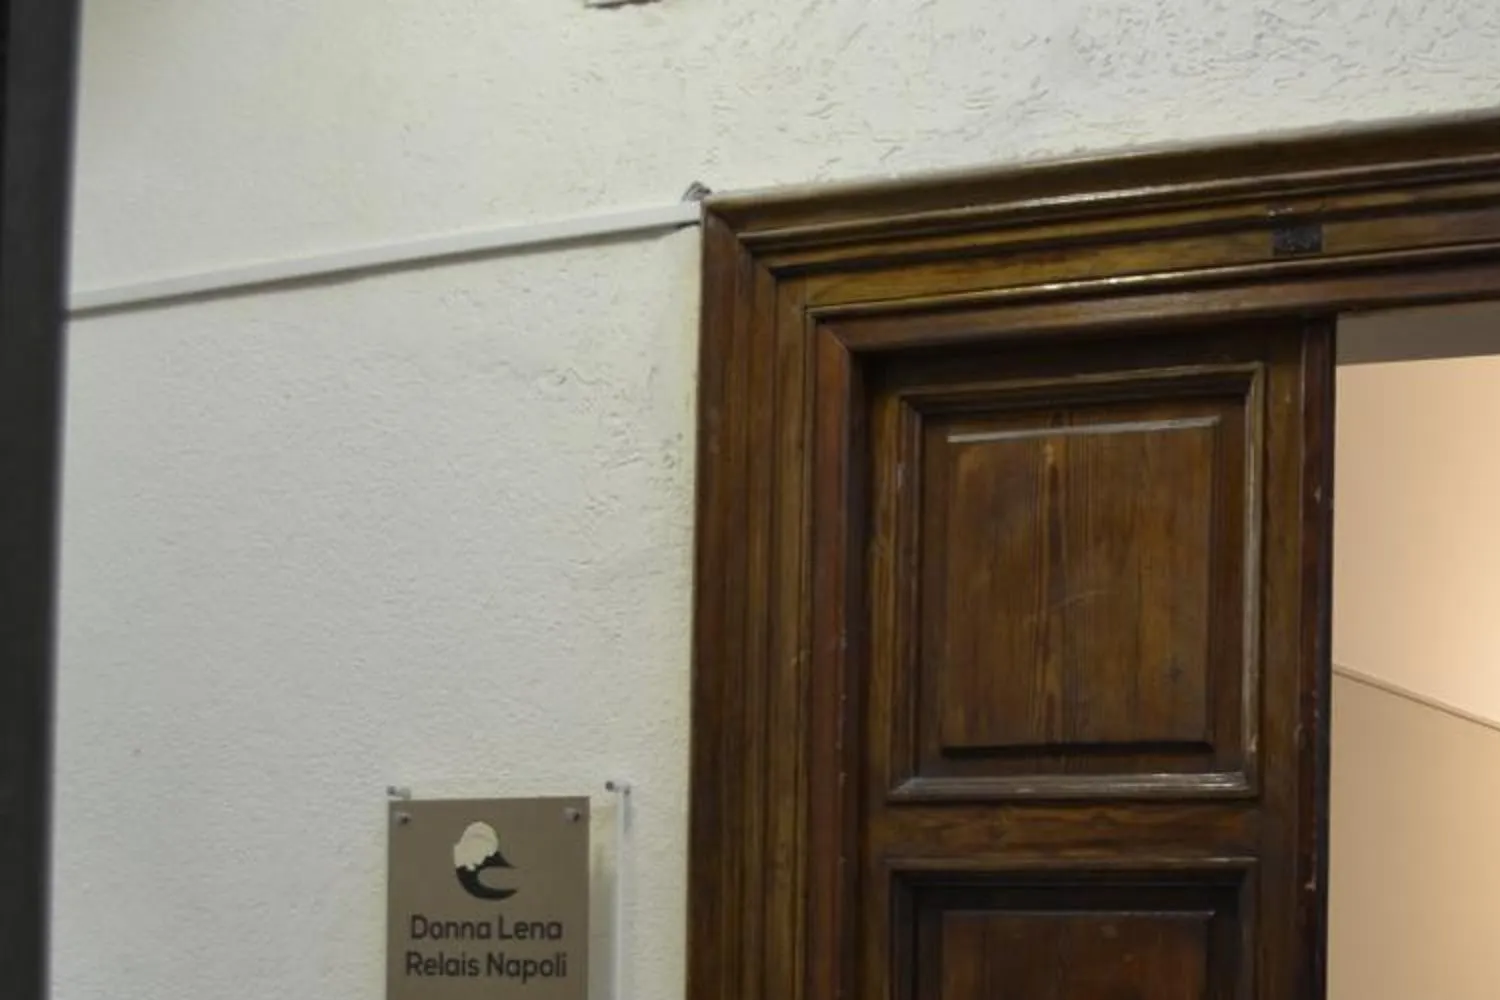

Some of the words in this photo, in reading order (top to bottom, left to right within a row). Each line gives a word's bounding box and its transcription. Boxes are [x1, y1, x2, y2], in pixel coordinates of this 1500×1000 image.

[411, 914, 491, 940] Donna
[498, 914, 562, 940] Lena
[406, 951, 480, 976] Relais
[487, 951, 568, 984] Napoli
